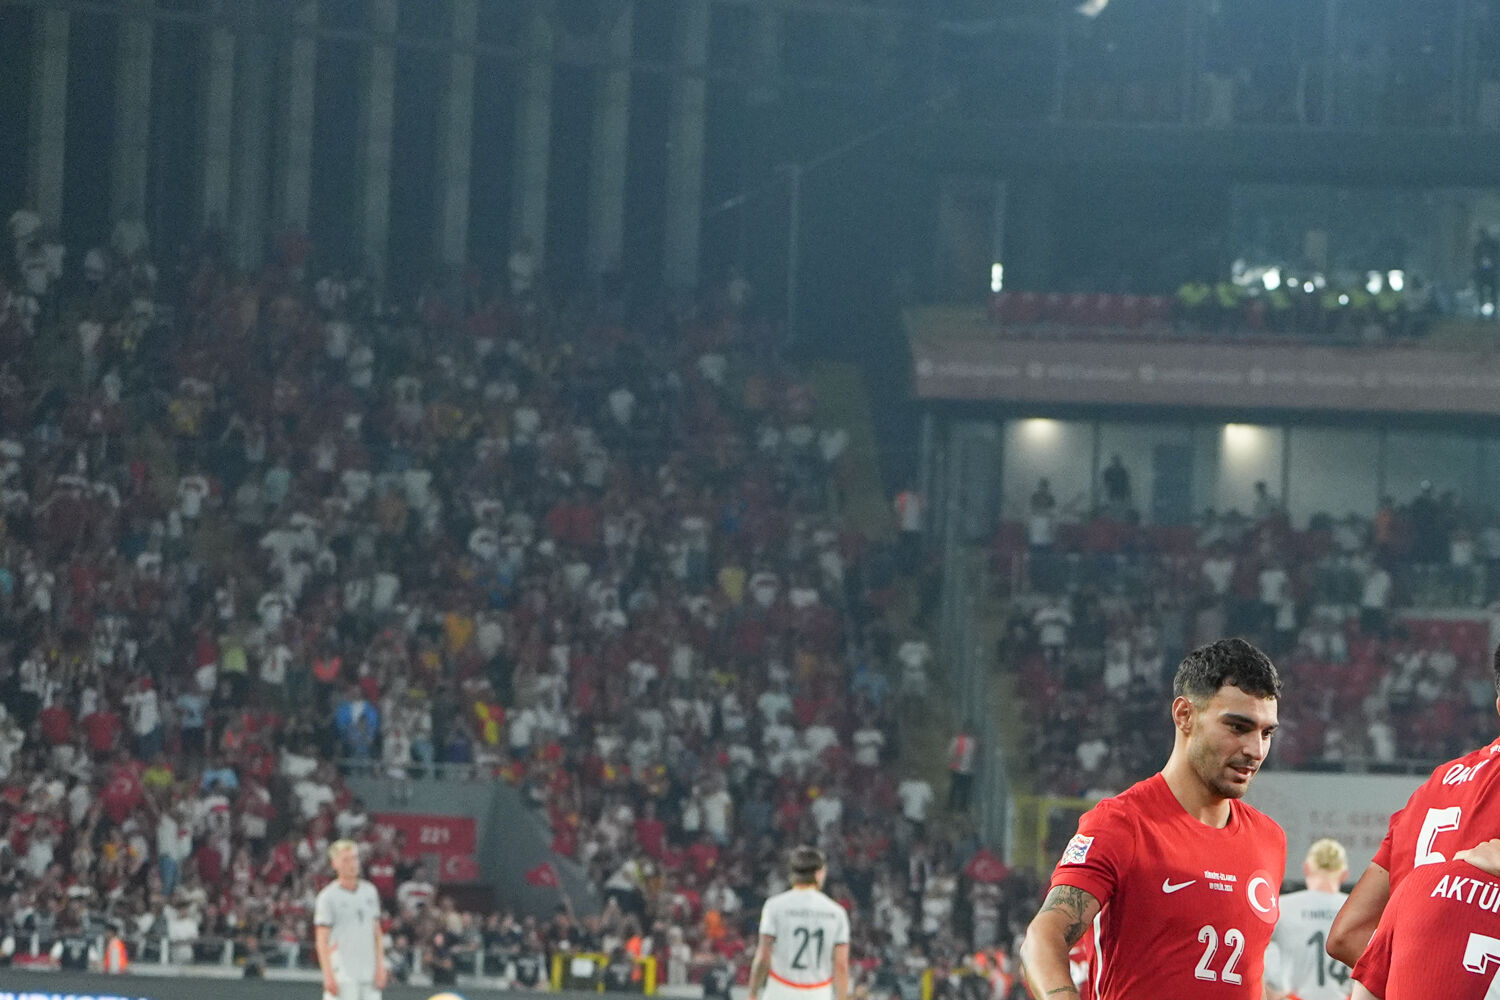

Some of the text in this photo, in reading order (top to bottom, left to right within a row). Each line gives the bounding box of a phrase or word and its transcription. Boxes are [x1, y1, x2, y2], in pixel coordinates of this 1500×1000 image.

[791, 926, 824, 970] 21
[1195, 925, 1245, 985] 22
[1307, 930, 1349, 988] 14
